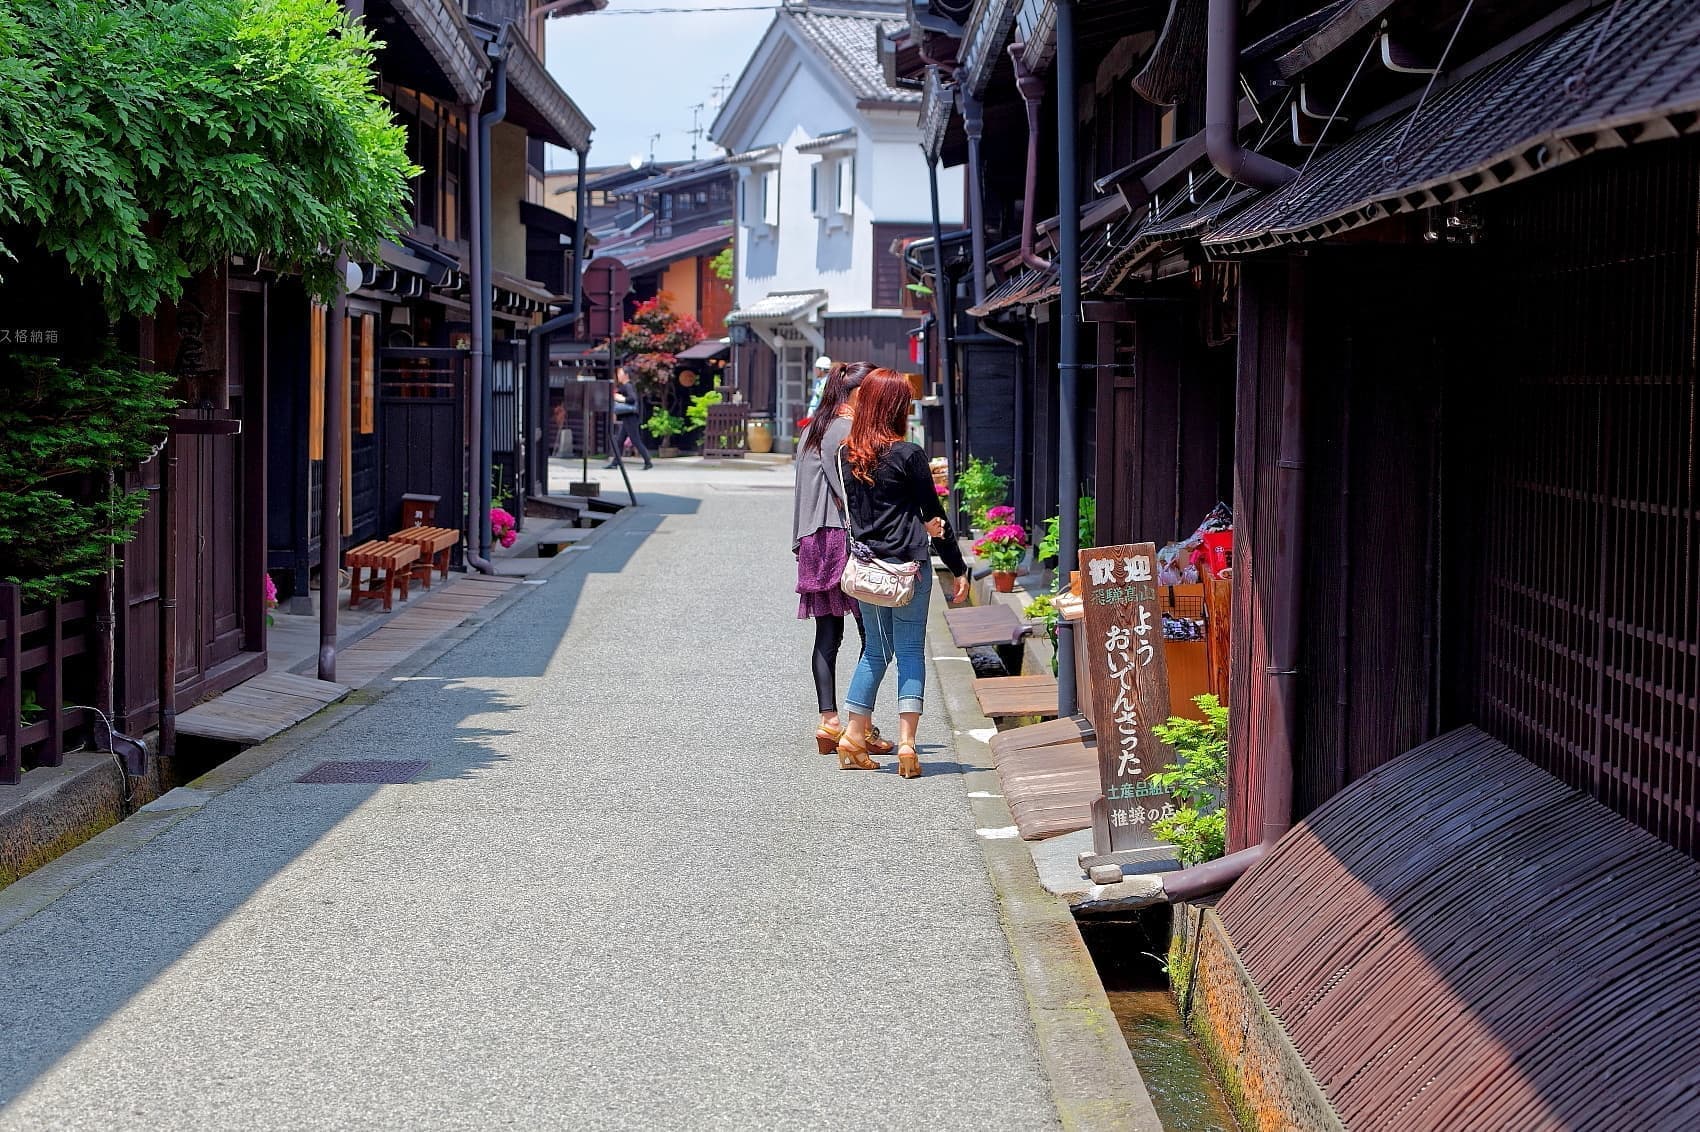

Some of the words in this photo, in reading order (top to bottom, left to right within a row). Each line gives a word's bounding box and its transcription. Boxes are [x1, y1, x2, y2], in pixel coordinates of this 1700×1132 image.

[1089, 555, 1152, 586] 歓迎
[1134, 605, 1154, 666] よう
[1105, 625, 1142, 777] おいでんさった
